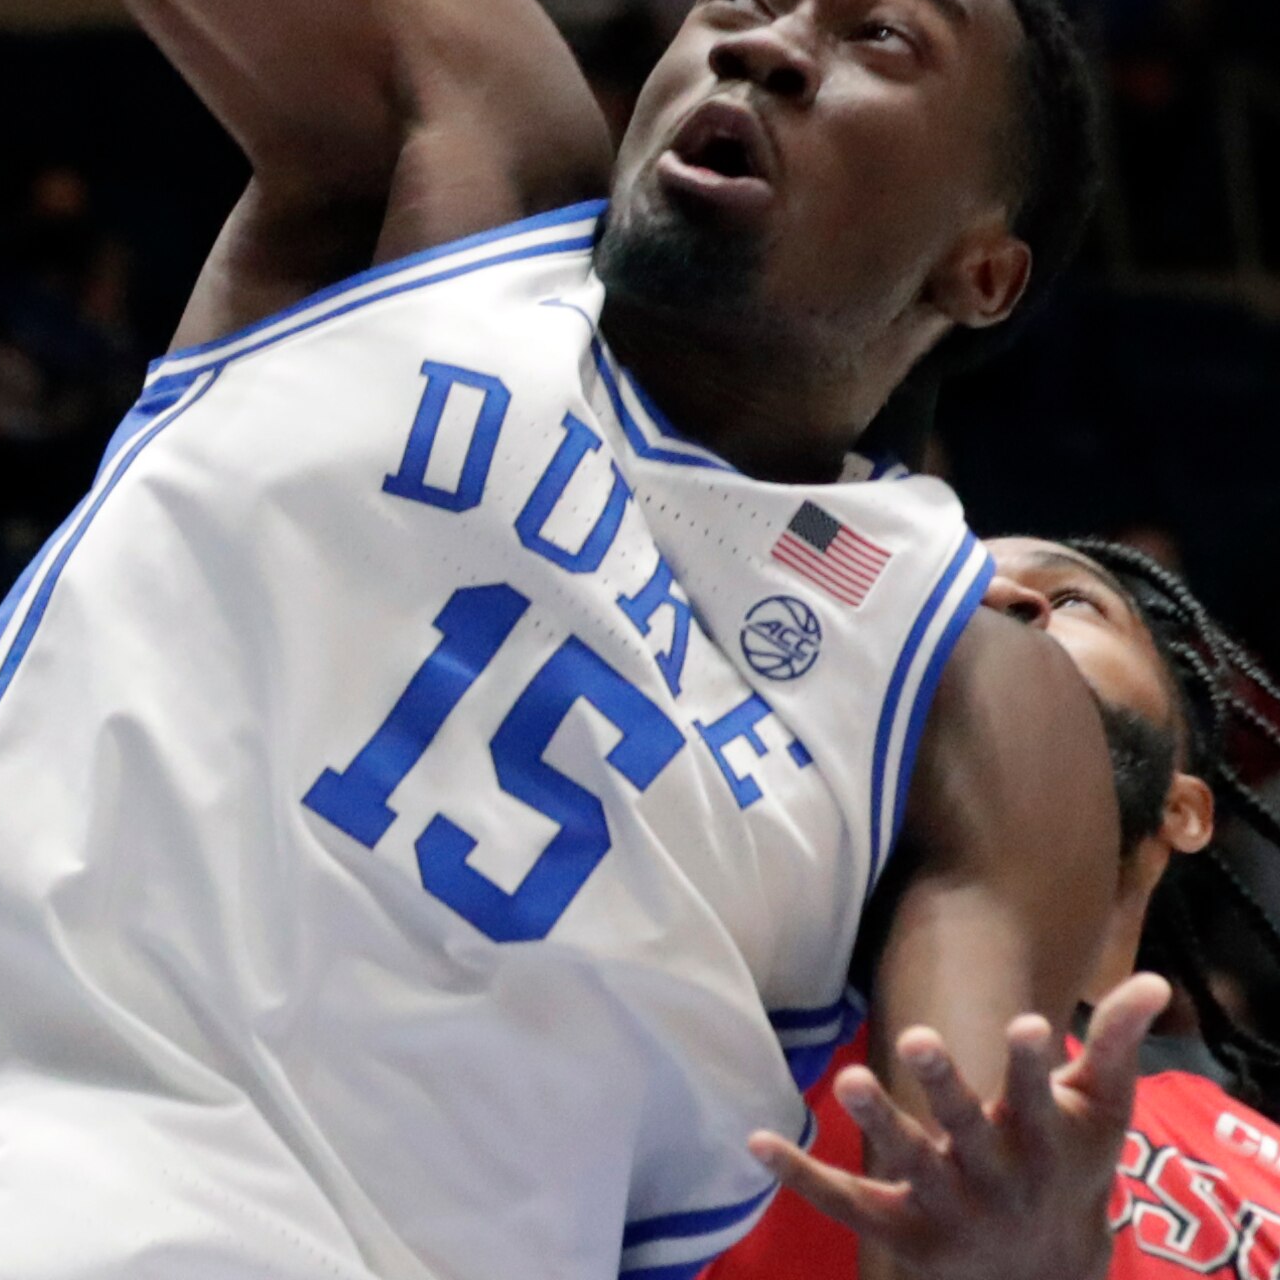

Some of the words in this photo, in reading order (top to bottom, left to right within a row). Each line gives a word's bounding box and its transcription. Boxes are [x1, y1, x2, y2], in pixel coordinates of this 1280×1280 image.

[300, 582, 688, 943] 15
[381, 358, 814, 810] DUKE
[750, 619, 818, 661] ACC
